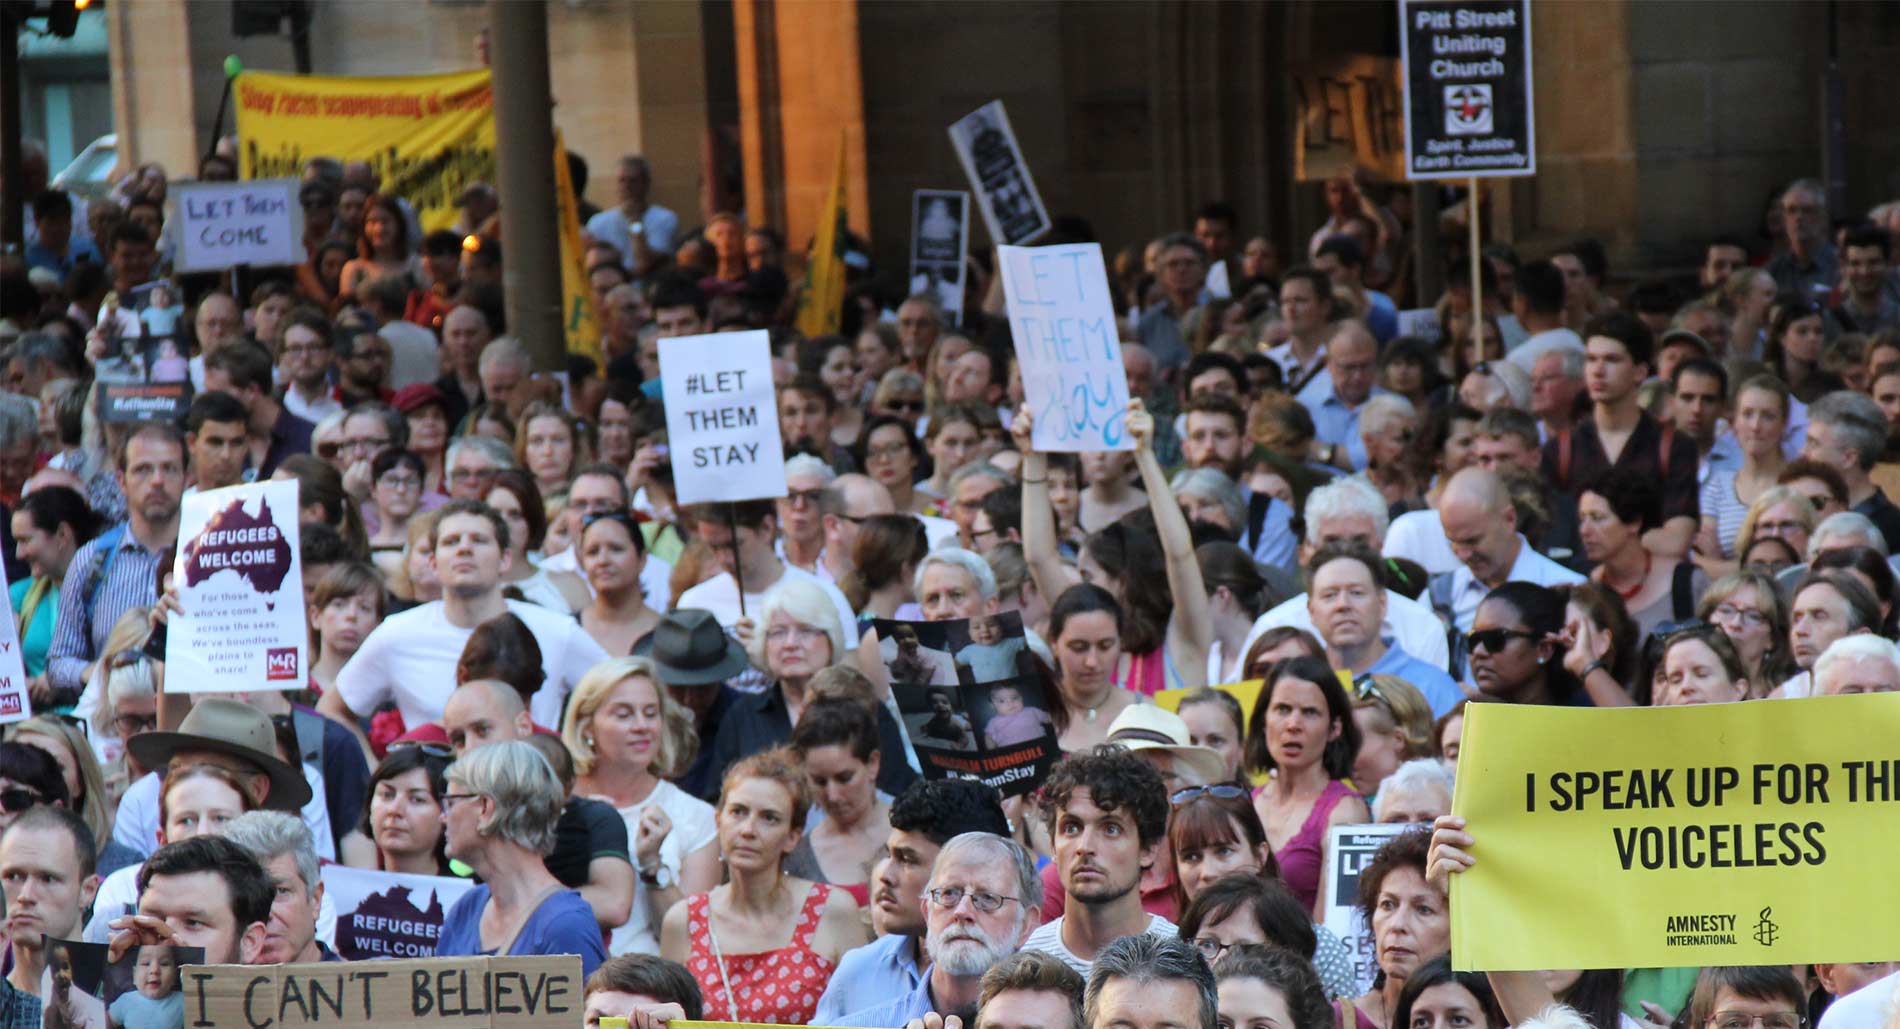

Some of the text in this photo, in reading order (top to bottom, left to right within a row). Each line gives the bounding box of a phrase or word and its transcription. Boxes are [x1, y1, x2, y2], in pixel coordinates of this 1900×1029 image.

[1416, 9, 1516, 29] Pitt Street
[1432, 34, 1506, 56] Uniting
[1430, 58, 1504, 78] Church
[1468, 138, 1515, 151] Justice
[1415, 153, 1527, 168] Earth Community
[186, 197, 236, 220] LET
[200, 225, 268, 248] COME
[1007, 251, 1089, 305] LET
[1018, 317, 1115, 362] THEM
[685, 370, 746, 395] #LET
[685, 406, 758, 431] THEM
[692, 442, 759, 468] STAY
[199, 526, 278, 547] REFUGEES
[199, 548, 276, 568] WELCOME
[201, 592, 249, 602] For those
[231, 608, 258, 616] come
[233, 622, 249, 631] the
[226, 636, 279, 647] boundless
[208, 651, 254, 662] plains to
[983, 745, 1046, 772] TURNBULL
[1526, 773, 1535, 812] I
[1550, 768, 1675, 812] SPEAK
[1686, 766, 1740, 807] UP
[1753, 763, 1830, 805] FOR
[1613, 821, 1827, 870] VOICELESS
[1666, 914, 1737, 933] AMNESTY
[354, 936, 438, 958] WELCOM
[1666, 934, 1738, 946] INTERNATIONAL
[190, 969, 570, 1029] I CAN'T BELIEVE
